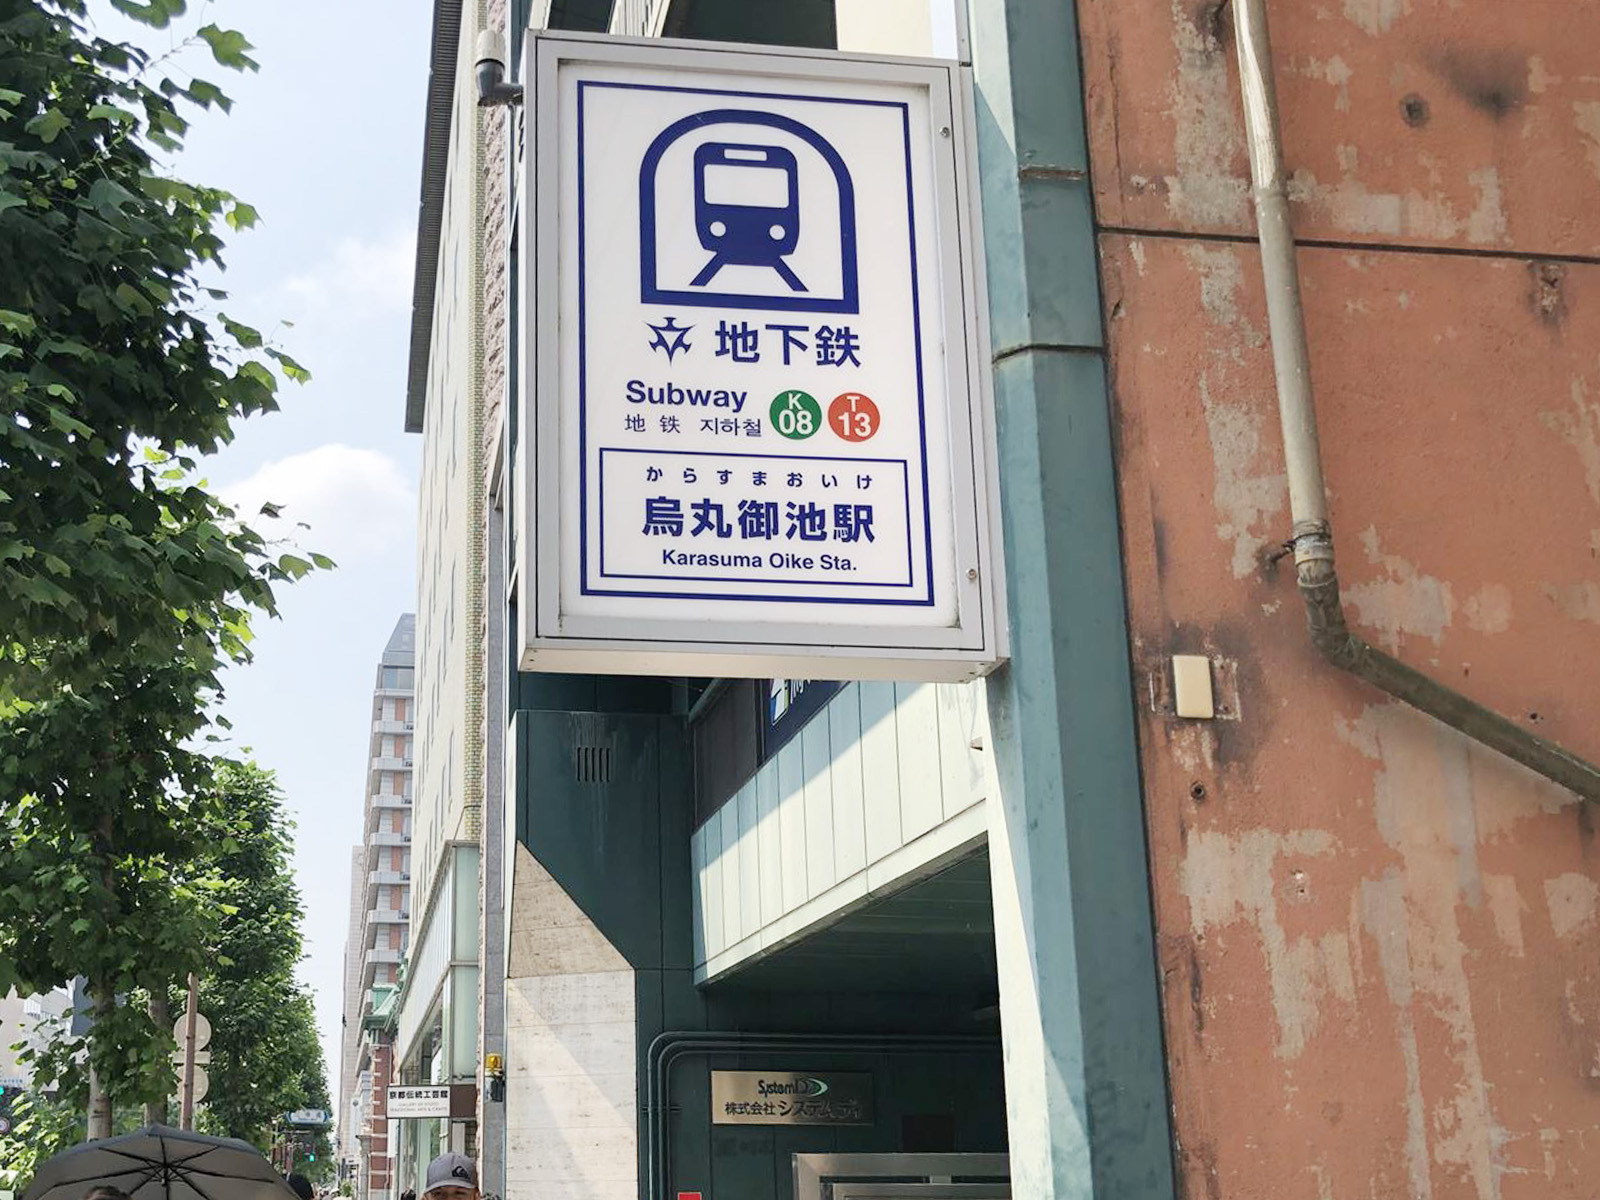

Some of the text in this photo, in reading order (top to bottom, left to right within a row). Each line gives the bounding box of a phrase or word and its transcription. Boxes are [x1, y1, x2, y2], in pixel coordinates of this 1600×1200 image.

[714, 320, 862, 368] 地下鉄
[625, 380, 748, 413] Subway
[788, 393, 803, 411] K
[846, 395, 861, 411] T
[624, 414, 681, 434] 地铁
[700, 417, 762, 438] 지하철
[777, 409, 814, 436] 08
[837, 412, 872, 438] 13
[646, 466, 873, 490] からすまおいけ
[642, 496, 876, 544] 烏丸御池駅
[662, 549, 858, 571] Karasuma Oike Sta.
